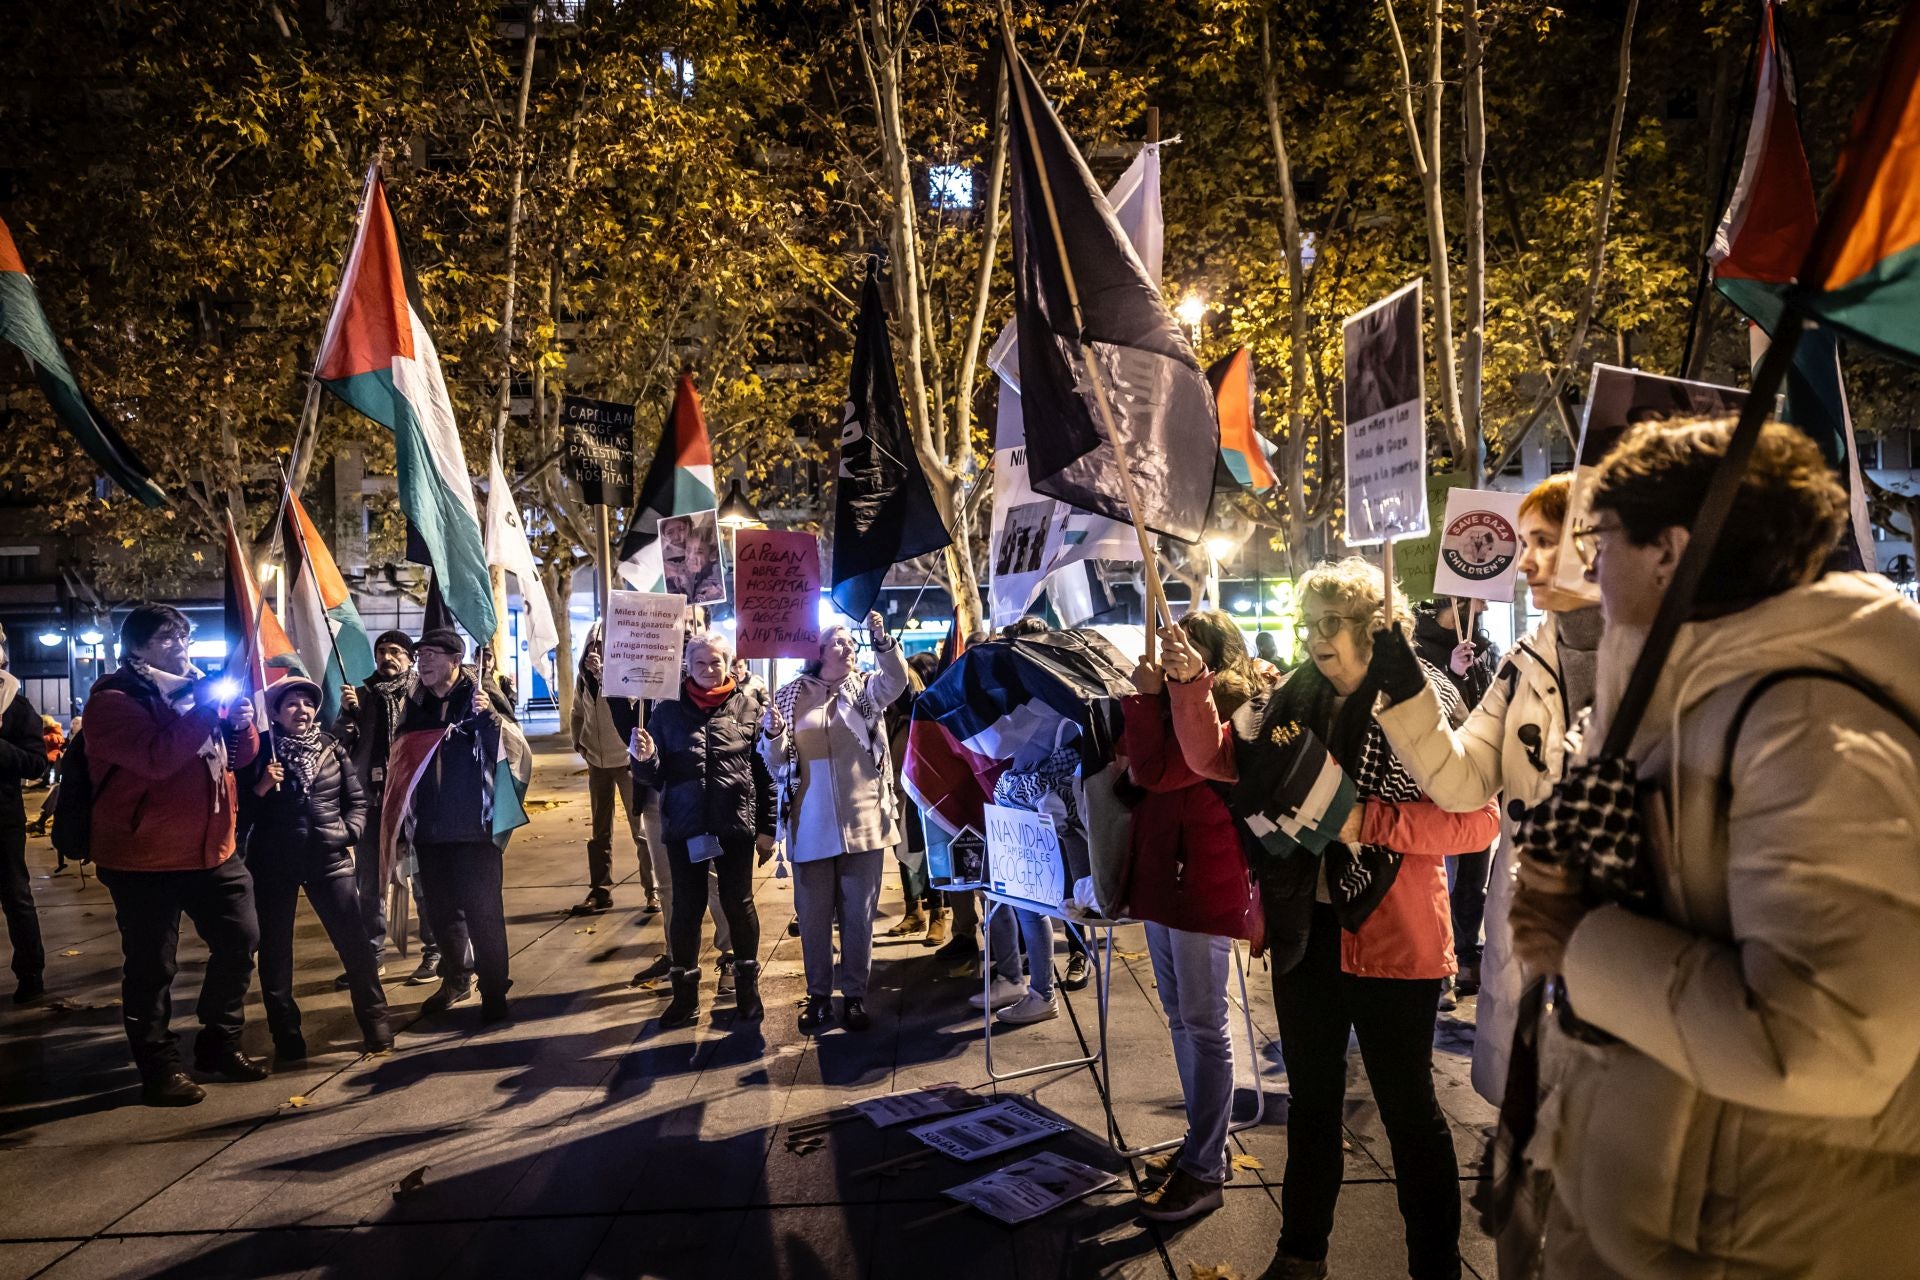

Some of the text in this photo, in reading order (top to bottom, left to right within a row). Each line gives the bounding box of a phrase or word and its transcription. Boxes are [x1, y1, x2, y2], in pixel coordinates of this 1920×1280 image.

[570, 406, 632, 426] CAPELLAN
[575, 422, 612, 435] ACOGE
[573, 433, 629, 449] FAMILIAS
[570, 445, 632, 462] PALESTINAS
[1375, 443, 1384, 456] de
[582, 458, 616, 472] EN EL
[575, 468, 632, 485] HOSPITAL
[1452, 515, 1480, 535] SAVE
[1482, 515, 1509, 540] GAZA
[1401, 543, 1437, 560] FAMI
[1407, 563, 1437, 576] PALE
[1448, 551, 1506, 575] CHILDREN'S
[752, 566, 806, 577] ABRE EL
[745, 580, 815, 593] HOSPITAL
[614, 608, 636, 616] Miles
[752, 611, 792, 624] ACOGE
[617, 619, 639, 627] niñas
[630, 630, 660, 639] heridos
[740, 628, 750, 643] A
[623, 651, 643, 661] lugar
[991, 819, 1056, 852] NAVIDAD
[1003, 845, 1052, 863] TAMBIEN ES
[992, 854, 1056, 889] ACOGER Y
